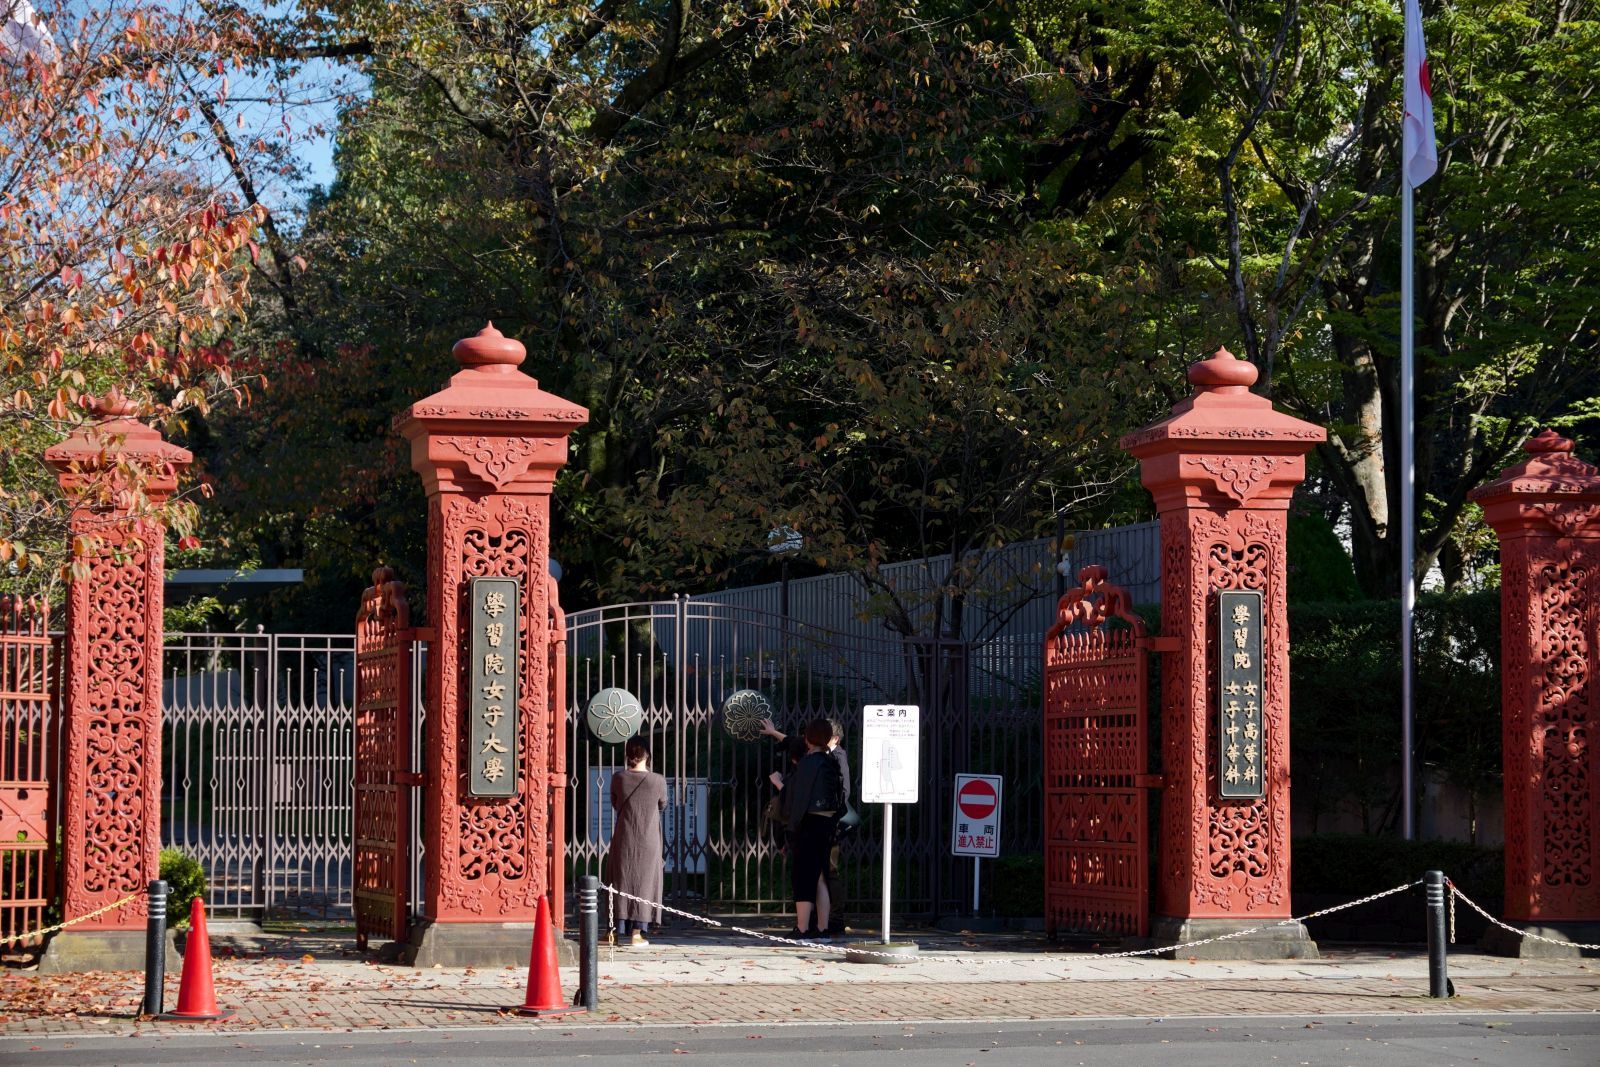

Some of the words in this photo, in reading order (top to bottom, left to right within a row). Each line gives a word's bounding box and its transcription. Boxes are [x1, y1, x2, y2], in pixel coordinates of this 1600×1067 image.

[481, 591, 508, 784] 學習院女子大學
[1232, 603, 1252, 670] 學習院
[1224, 680, 1241, 785] 女子中等科
[1243, 680, 1259, 785] 女子高等科
[957, 835, 994, 849] 進入禁止
